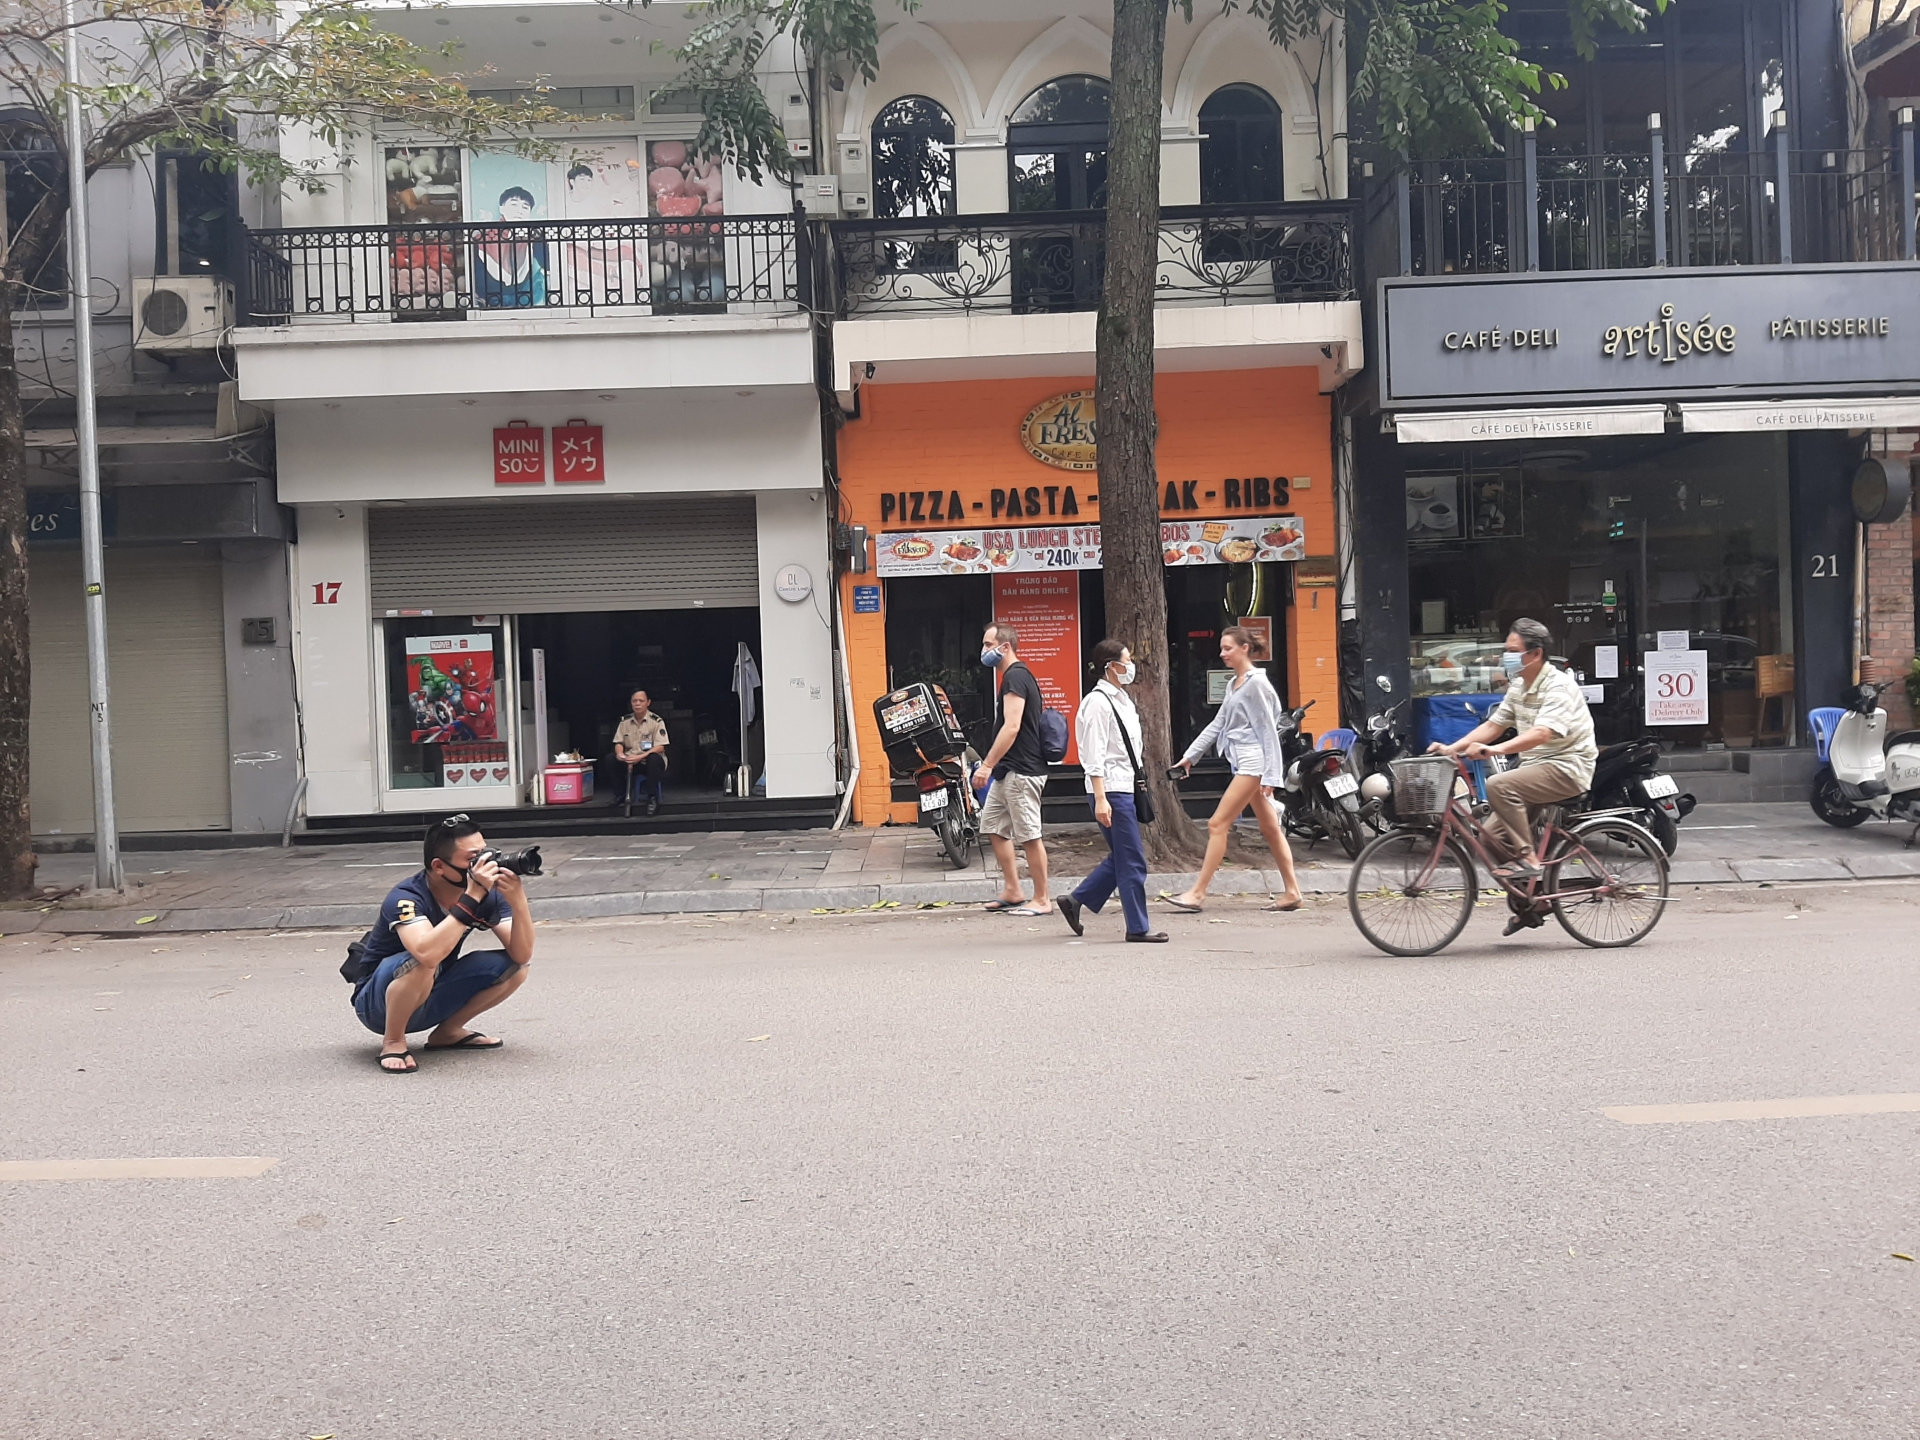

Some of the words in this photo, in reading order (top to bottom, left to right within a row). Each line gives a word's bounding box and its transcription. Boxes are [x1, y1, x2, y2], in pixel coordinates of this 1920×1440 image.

[1603, 302, 1737, 362] artisée
[1771, 316, 1890, 338] PÂTISSERIE
[1533, 420, 1593, 432] PÂTISSERIE
[1816, 411, 1876, 424] PÂTISSERIE
[499, 439, 539, 454] MINI
[881, 490, 965, 522] PIZZA
[991, 485, 1079, 518] PASTA
[1224, 476, 1290, 508] RIBS
[983, 530, 1014, 551] USA
[1018, 528, 1069, 549] LUNCH
[1811, 554, 1839, 577] 21
[311, 582, 343, 605] 17
[247, 620, 270, 637] 15
[397, 898, 416, 922] 3
